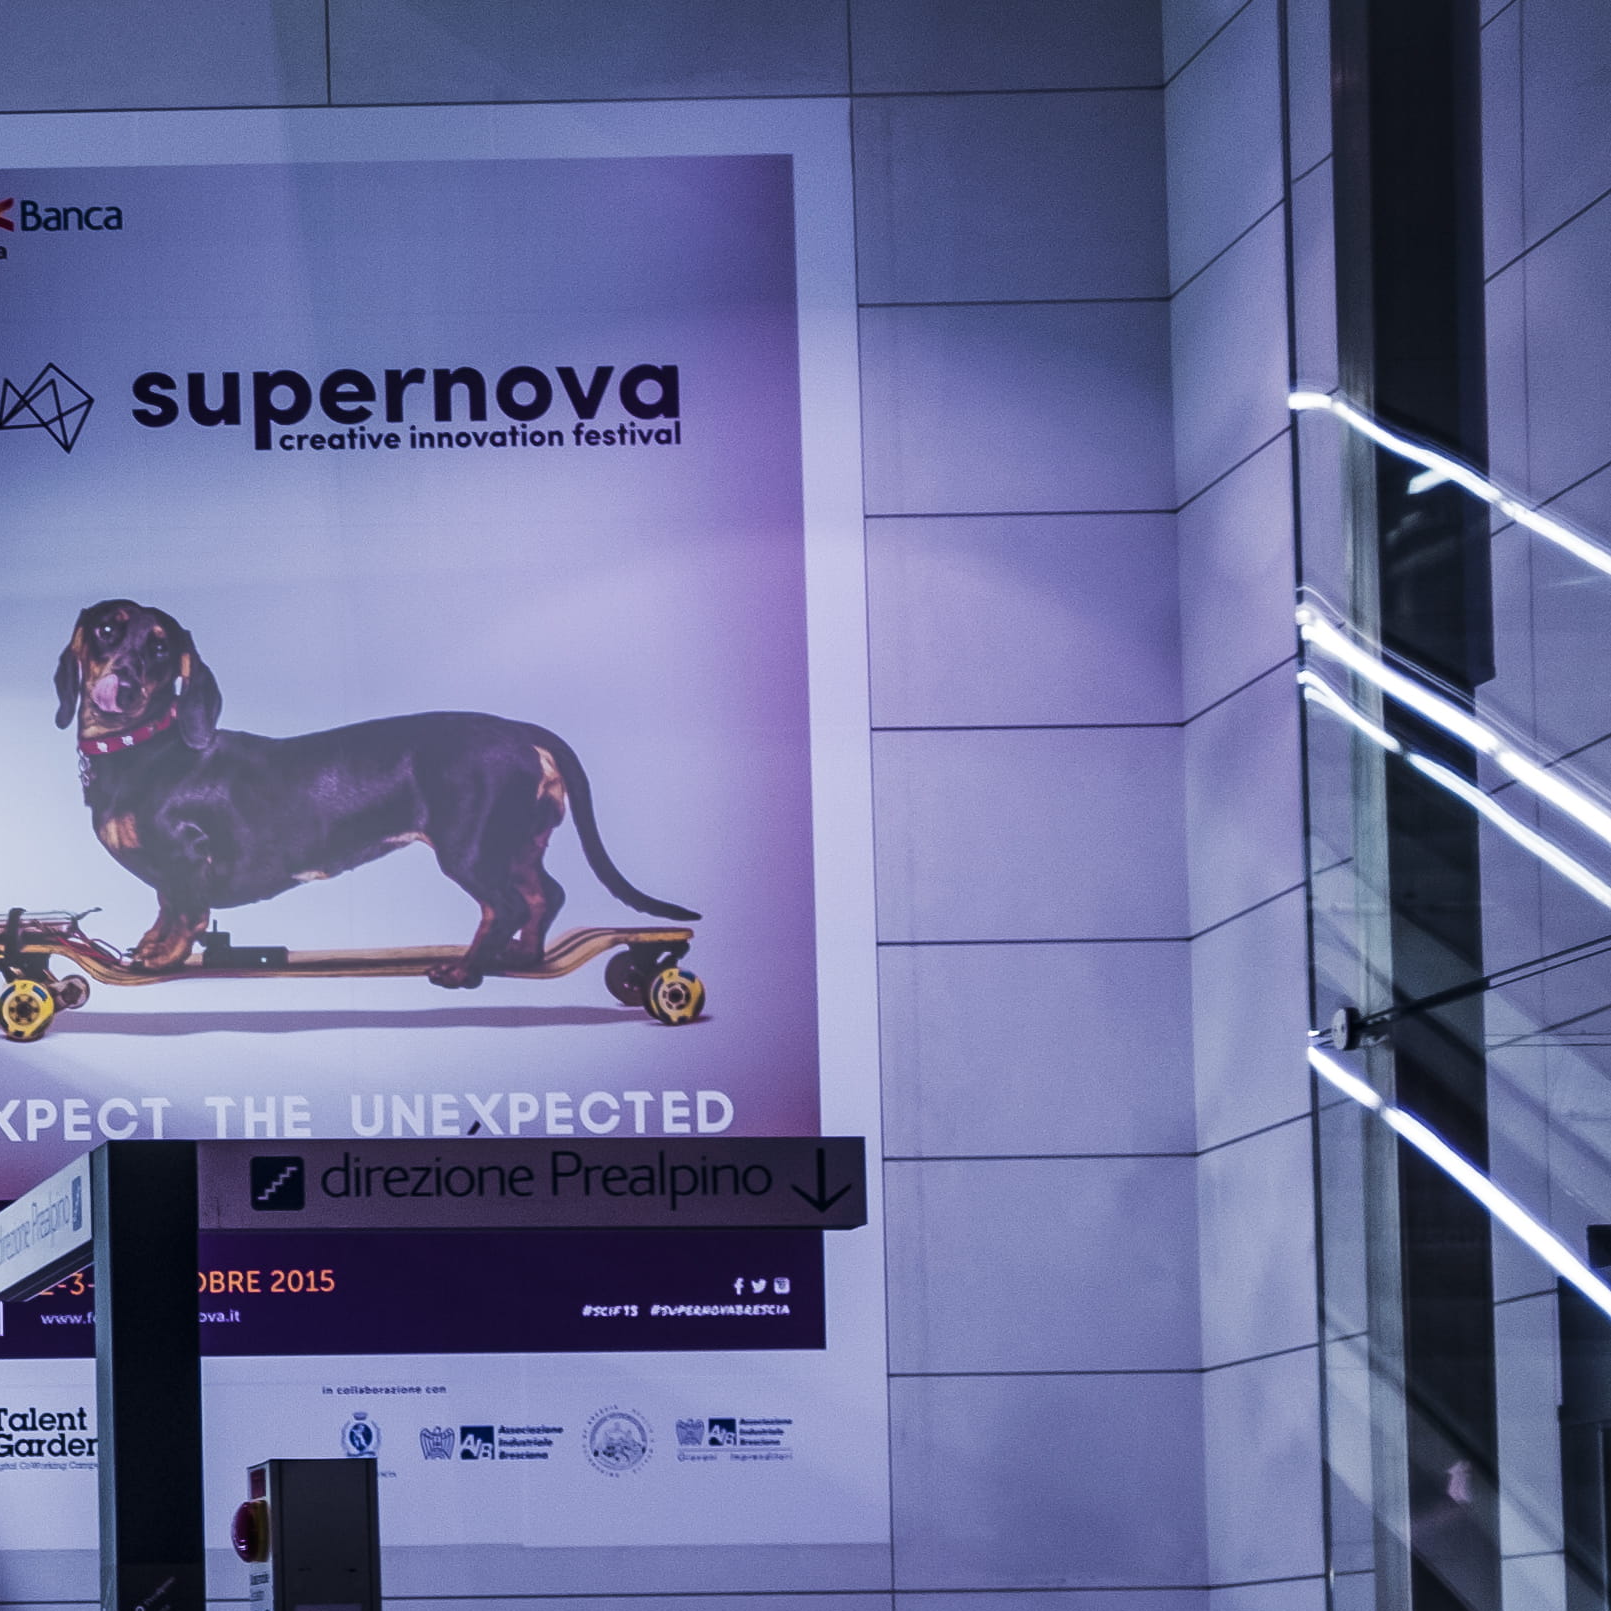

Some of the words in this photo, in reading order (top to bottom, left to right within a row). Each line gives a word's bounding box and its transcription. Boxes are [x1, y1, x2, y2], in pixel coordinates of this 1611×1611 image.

[20, 200, 123, 232] Banca
[132, 364, 681, 451] supernova
[278, 424, 401, 451] creative
[409, 420, 564, 449] innovation
[573, 418, 682, 447] festival
[204, 1095, 312, 1139] THE
[350, 1089, 735, 1138] UNEXPECTED
[320, 1151, 535, 1198] direzione
[551, 1150, 774, 1211] Prealpino
[270, 1269, 335, 1293] 2015
